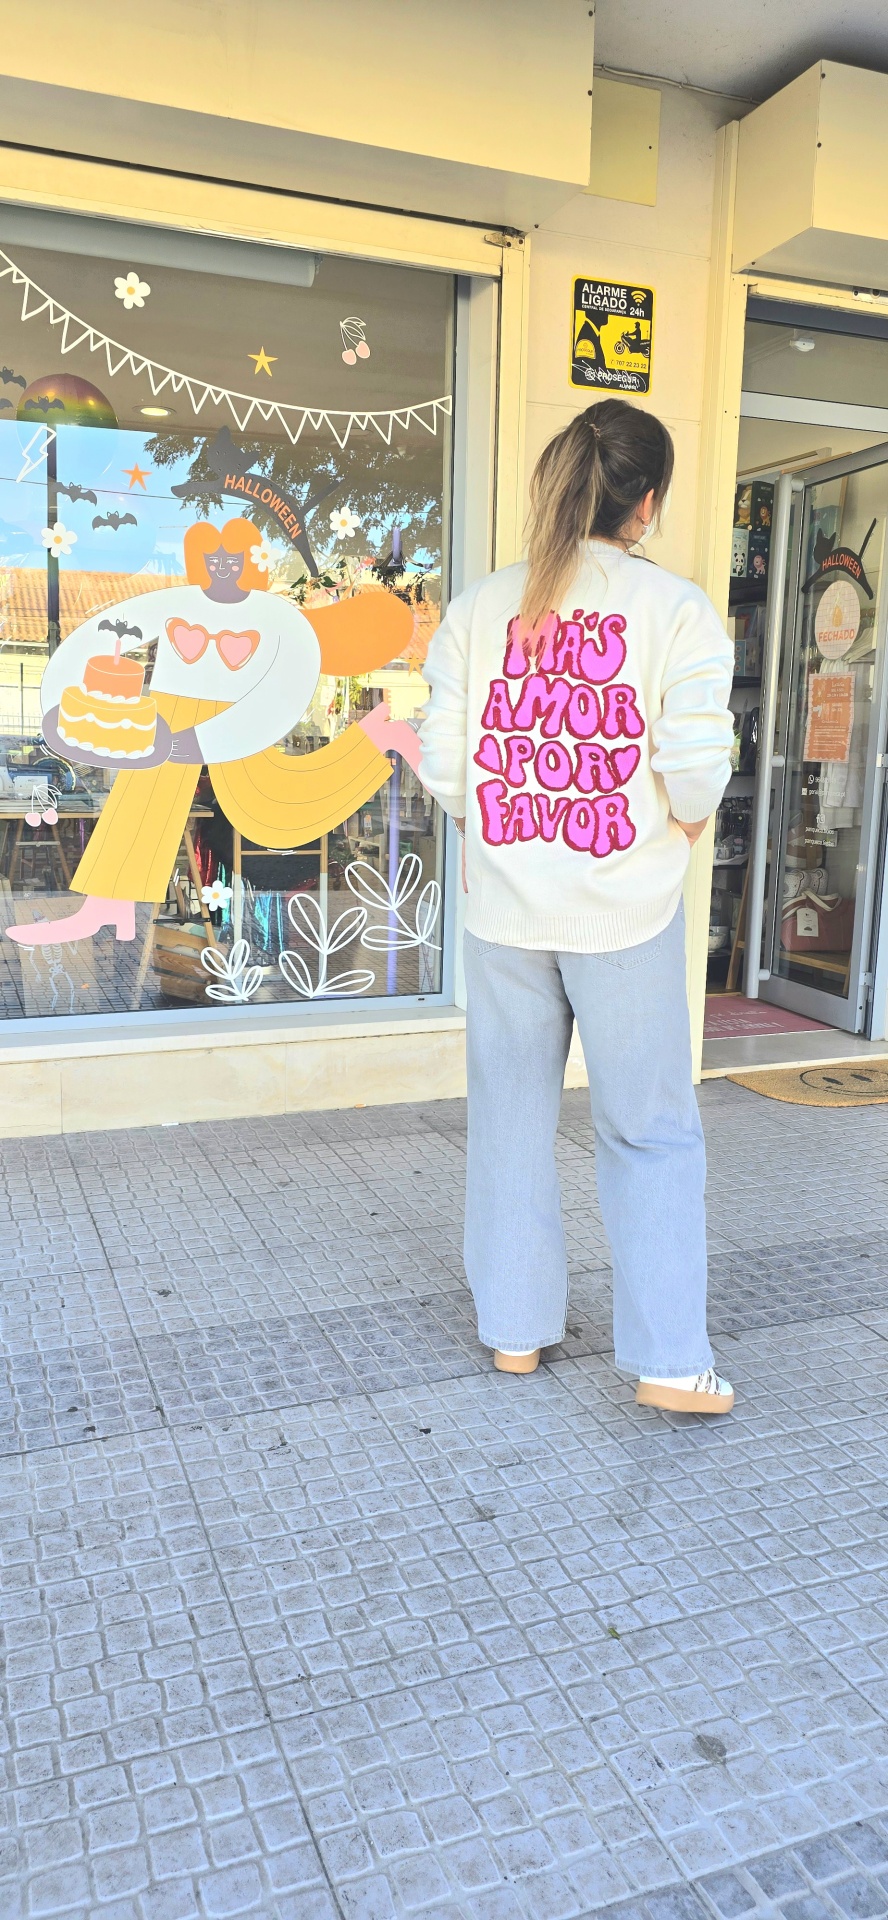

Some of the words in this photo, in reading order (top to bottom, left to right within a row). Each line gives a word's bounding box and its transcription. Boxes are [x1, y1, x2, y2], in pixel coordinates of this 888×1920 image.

[581, 293, 627, 310] LIGADO
[582, 283, 627, 299] ALARME
[629, 307, 645, 317] 24h
[598, 370, 637, 384] PROSEGUR
[224, 474, 302, 540] HALLOWEEN
[822, 553, 861, 579] HALLOWEEN
[818, 628, 855, 643] FECHADO
[480, 673, 645, 740] AMOR
[503, 735, 617, 794] POR
[476, 779, 637, 859] FAVOR
